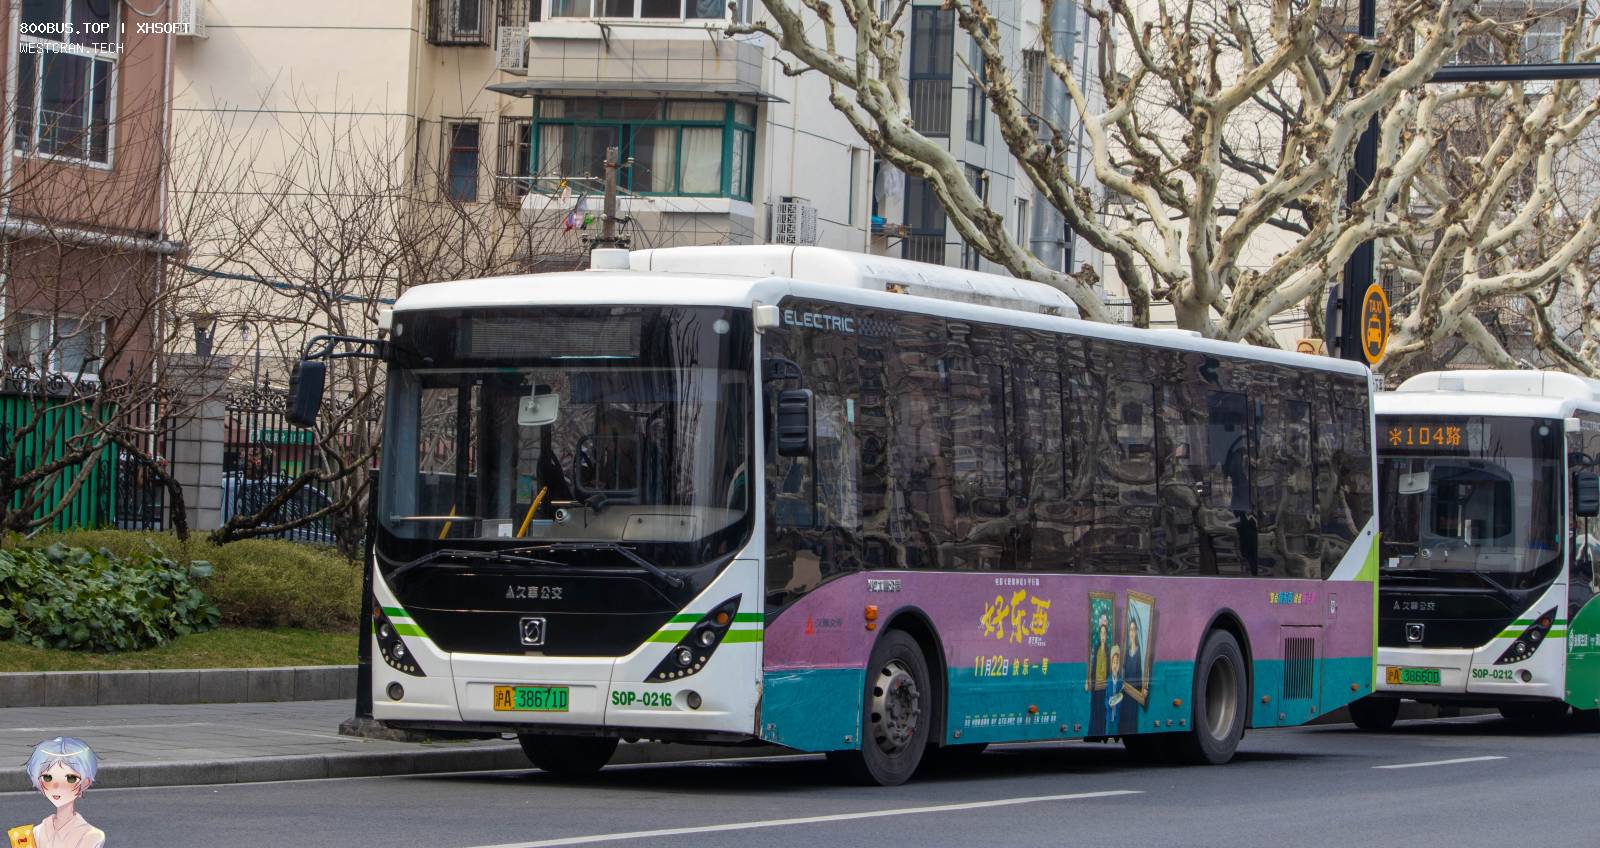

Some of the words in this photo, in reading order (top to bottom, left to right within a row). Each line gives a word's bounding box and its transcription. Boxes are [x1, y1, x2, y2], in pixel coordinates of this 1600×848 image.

[1369, 299, 1382, 313] TAXI
[784, 309, 855, 333] ELECTRIC
[515, 586, 563, 599] 久事公交
[974, 655, 1009, 677] 11月22日
[1472, 668, 1513, 679] SOP-0212
[518, 689, 568, 709] 38671D
[611, 690, 673, 707] SOP-0216
